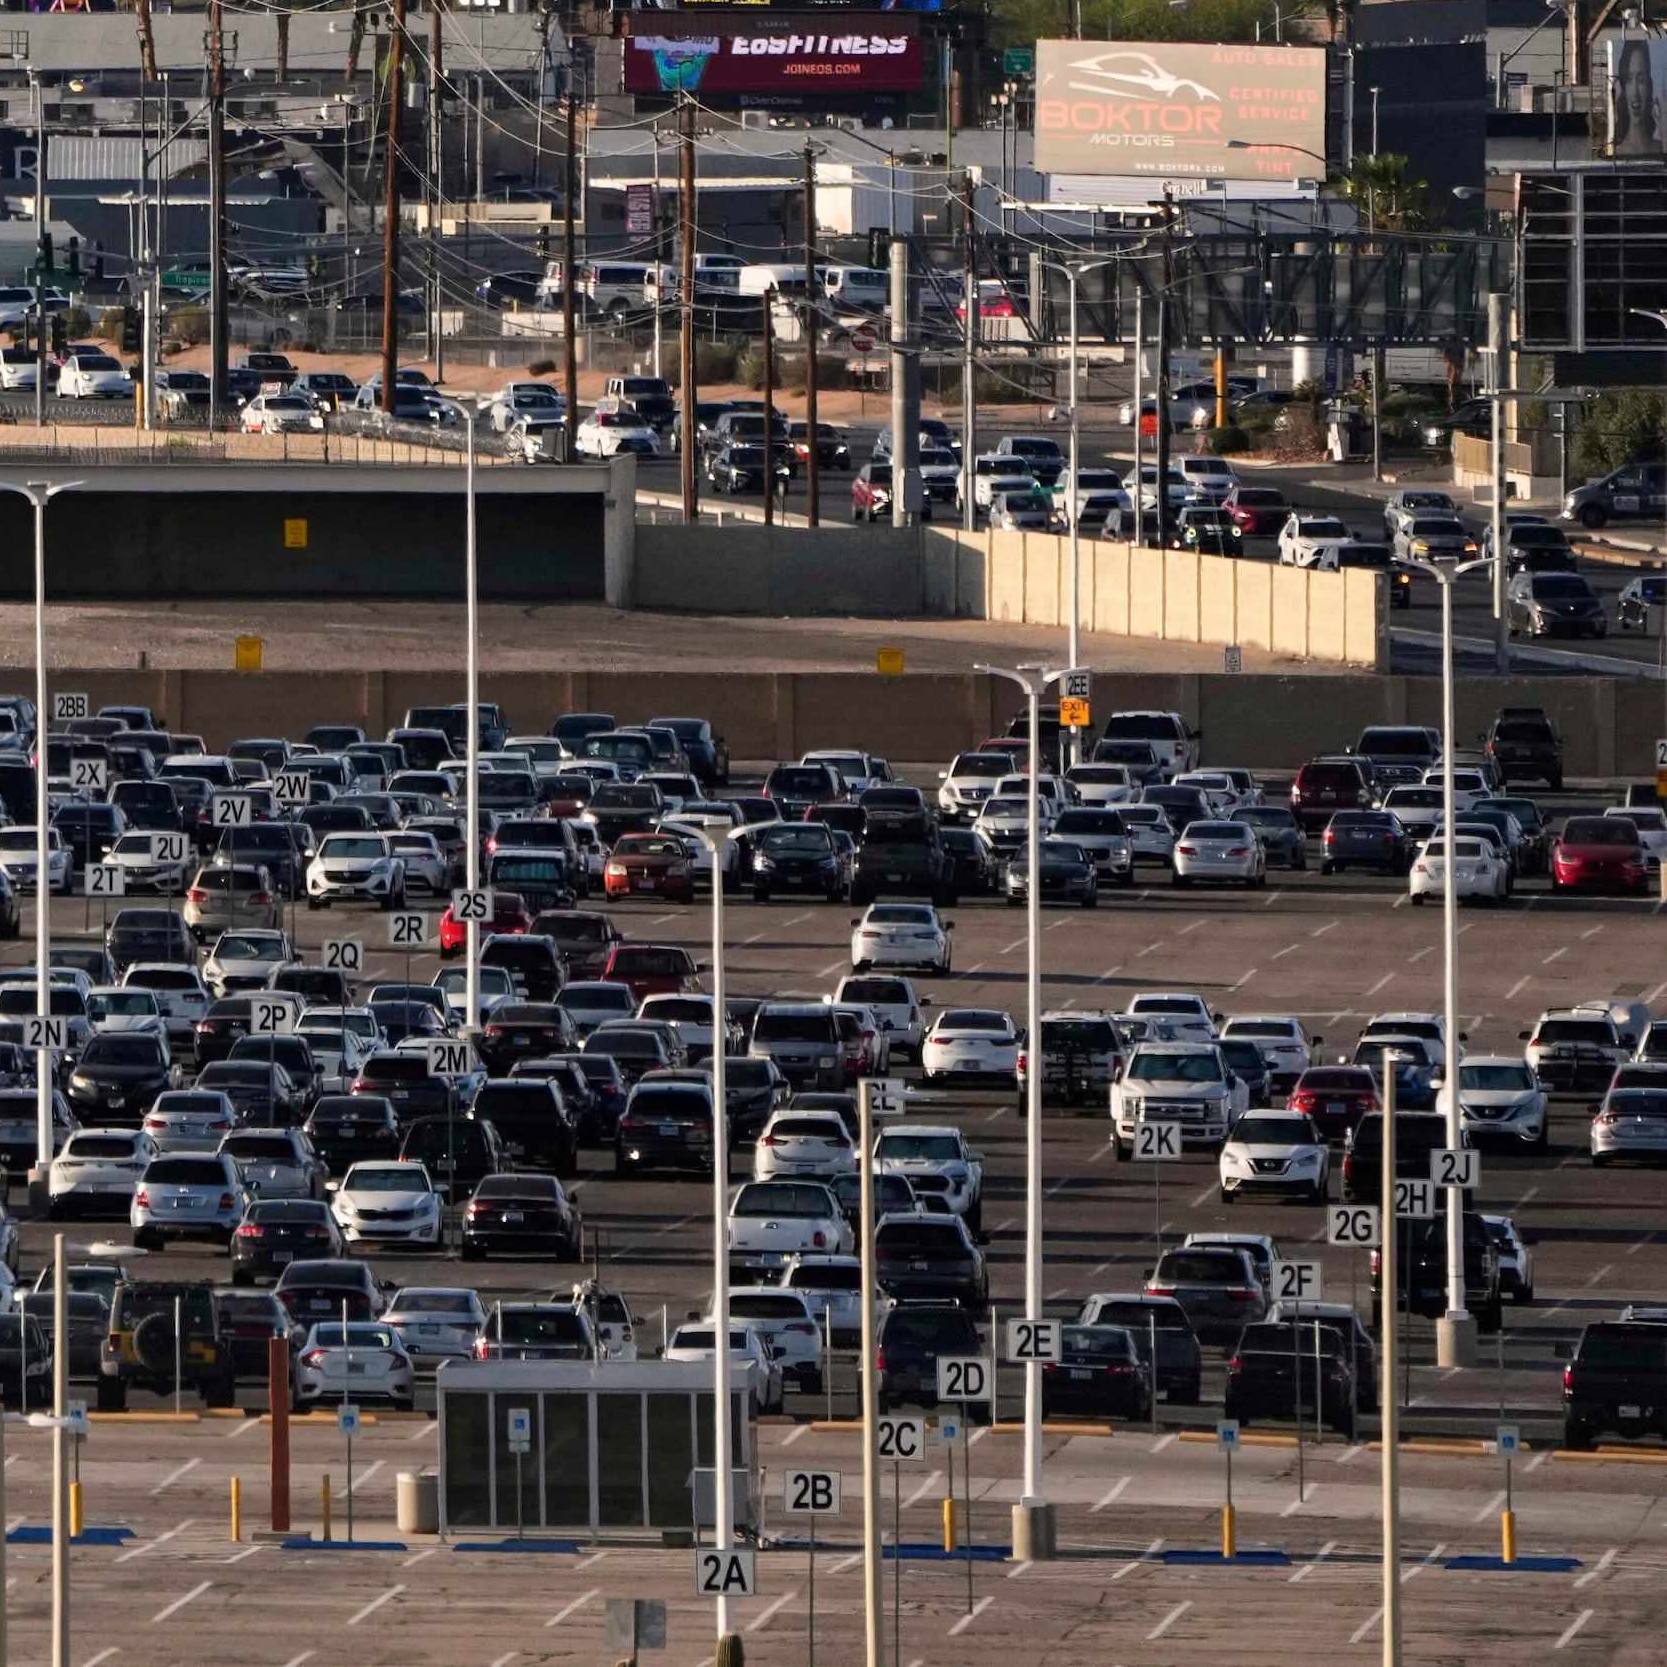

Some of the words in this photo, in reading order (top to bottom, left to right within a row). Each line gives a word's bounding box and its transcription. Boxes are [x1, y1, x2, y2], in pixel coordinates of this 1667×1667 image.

[783, 64, 861, 75] JOINEOS.COM
[1213, 52, 1257, 65] AUTO
[1265, 53, 1318, 66] SALES
[1229, 87, 1319, 103] CERTIFIED
[1040, 100, 1223, 134] BOKTOR
[1238, 105, 1310, 121] SERVICE
[1088, 133, 1175, 147] MOTORS
[1256, 161, 1293, 174] TINT
[1067, 674, 1088, 697] 2EE
[57, 696, 86, 718] 2BB
[1061, 700, 1087, 712] EXIT
[75, 762, 101, 786] 2X
[275, 775, 308, 799] 2W
[219, 799, 246, 824] 2V
[157, 836, 183, 861] 2U
[92, 866, 119, 892] 2T
[460, 892, 487, 919] 2S
[393, 915, 423, 943] 2R
[327, 942, 359, 972] 2Q
[258, 1003, 287, 1031] 2P
[30, 1020, 61, 1047] 2N
[433, 1045, 467, 1073] 2M
[1140, 1125, 1175, 1155] 2K
[1440, 1153, 1471, 1185] 2J
[1394, 1183, 1428, 1215] 2H
[1334, 1209, 1373, 1242] 2G
[1280, 1264, 1313, 1298] 2F
[1016, 1324, 1053, 1358] 2E
[946, 1361, 985, 1396] 2D
[878, 1421, 917, 1457] 2C
[793, 1474, 834, 1510] 2B
[702, 1555, 749, 1593] 2A
